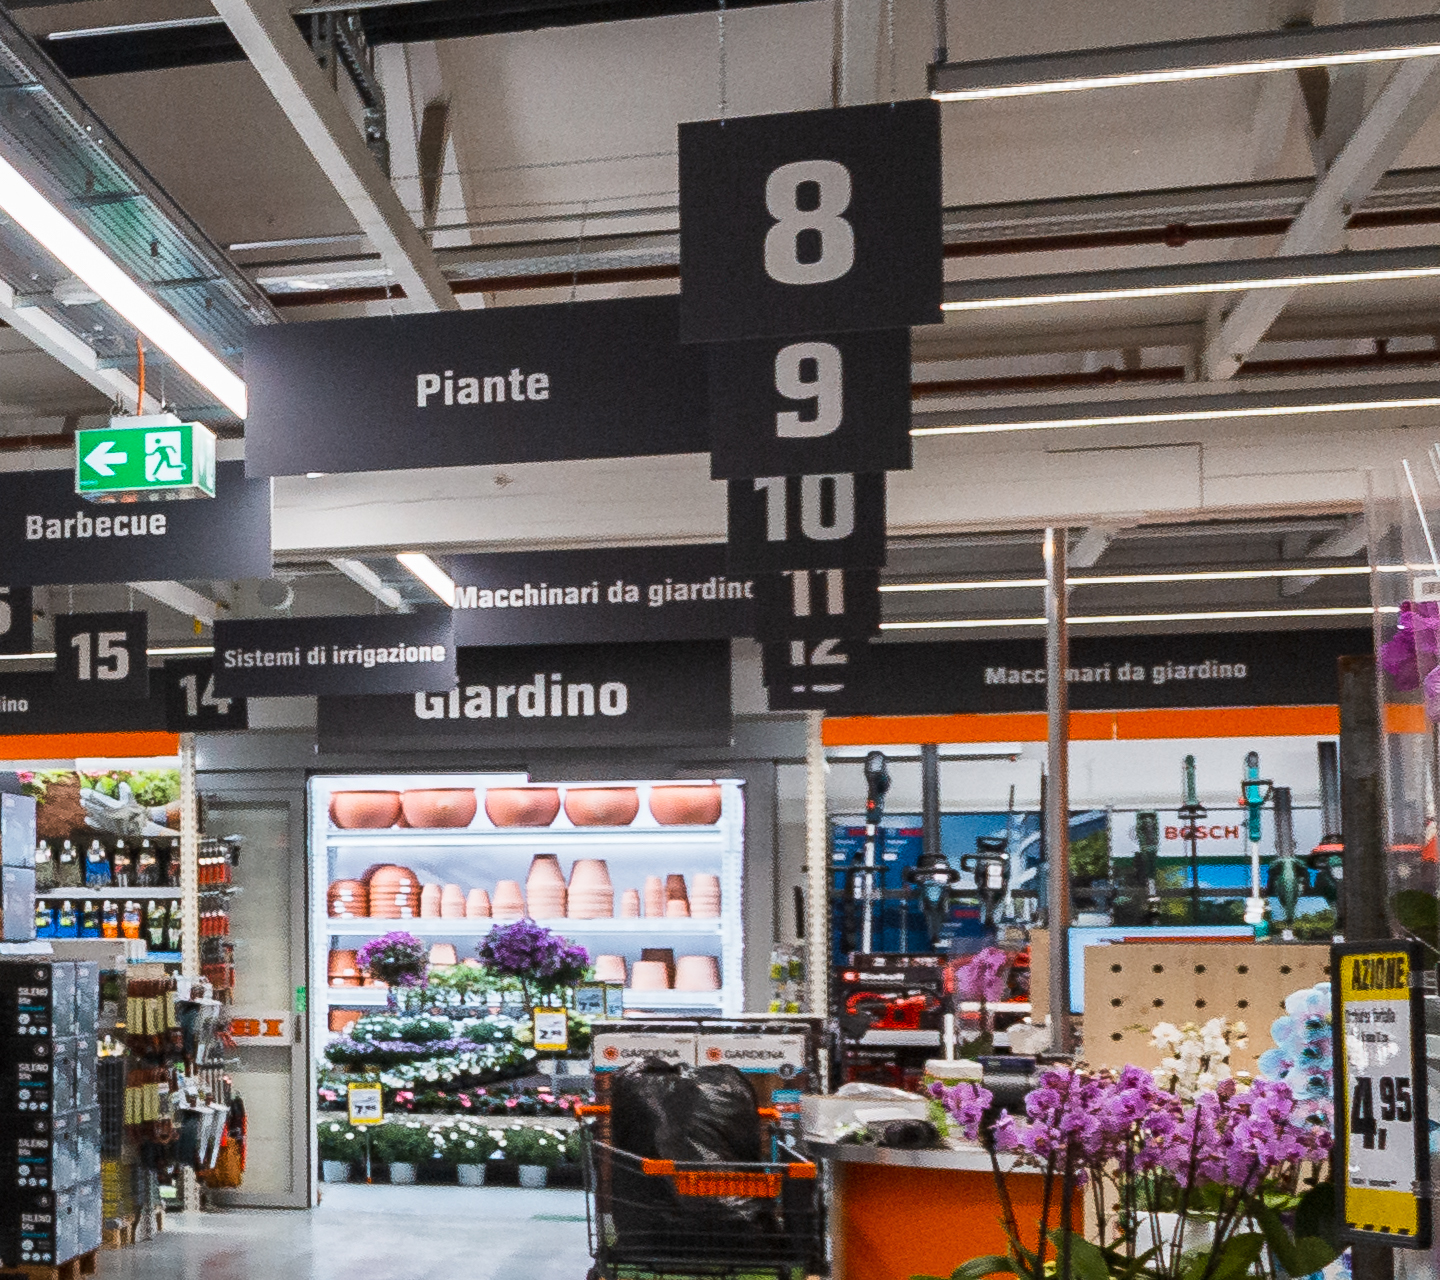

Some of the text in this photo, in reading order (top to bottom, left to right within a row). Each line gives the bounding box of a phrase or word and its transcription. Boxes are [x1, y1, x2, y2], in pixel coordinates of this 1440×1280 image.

[763, 159, 856, 286] 8
[416, 367, 550, 408] Piante
[774, 341, 844, 439] 9
[26, 510, 167, 540] Barbecue
[753, 471, 855, 542] 10
[453, 582, 599, 609] Macchinari
[608, 580, 640, 604] da
[783, 569, 845, 617] 11
[71, 631, 129, 681] 15
[224, 642, 445, 669] Sistemi di irrigazione
[985, 660, 1247, 685] Maccnari da giardino
[414, 674, 628, 720] Giardino
[1351, 956, 1406, 991] AZIONE
